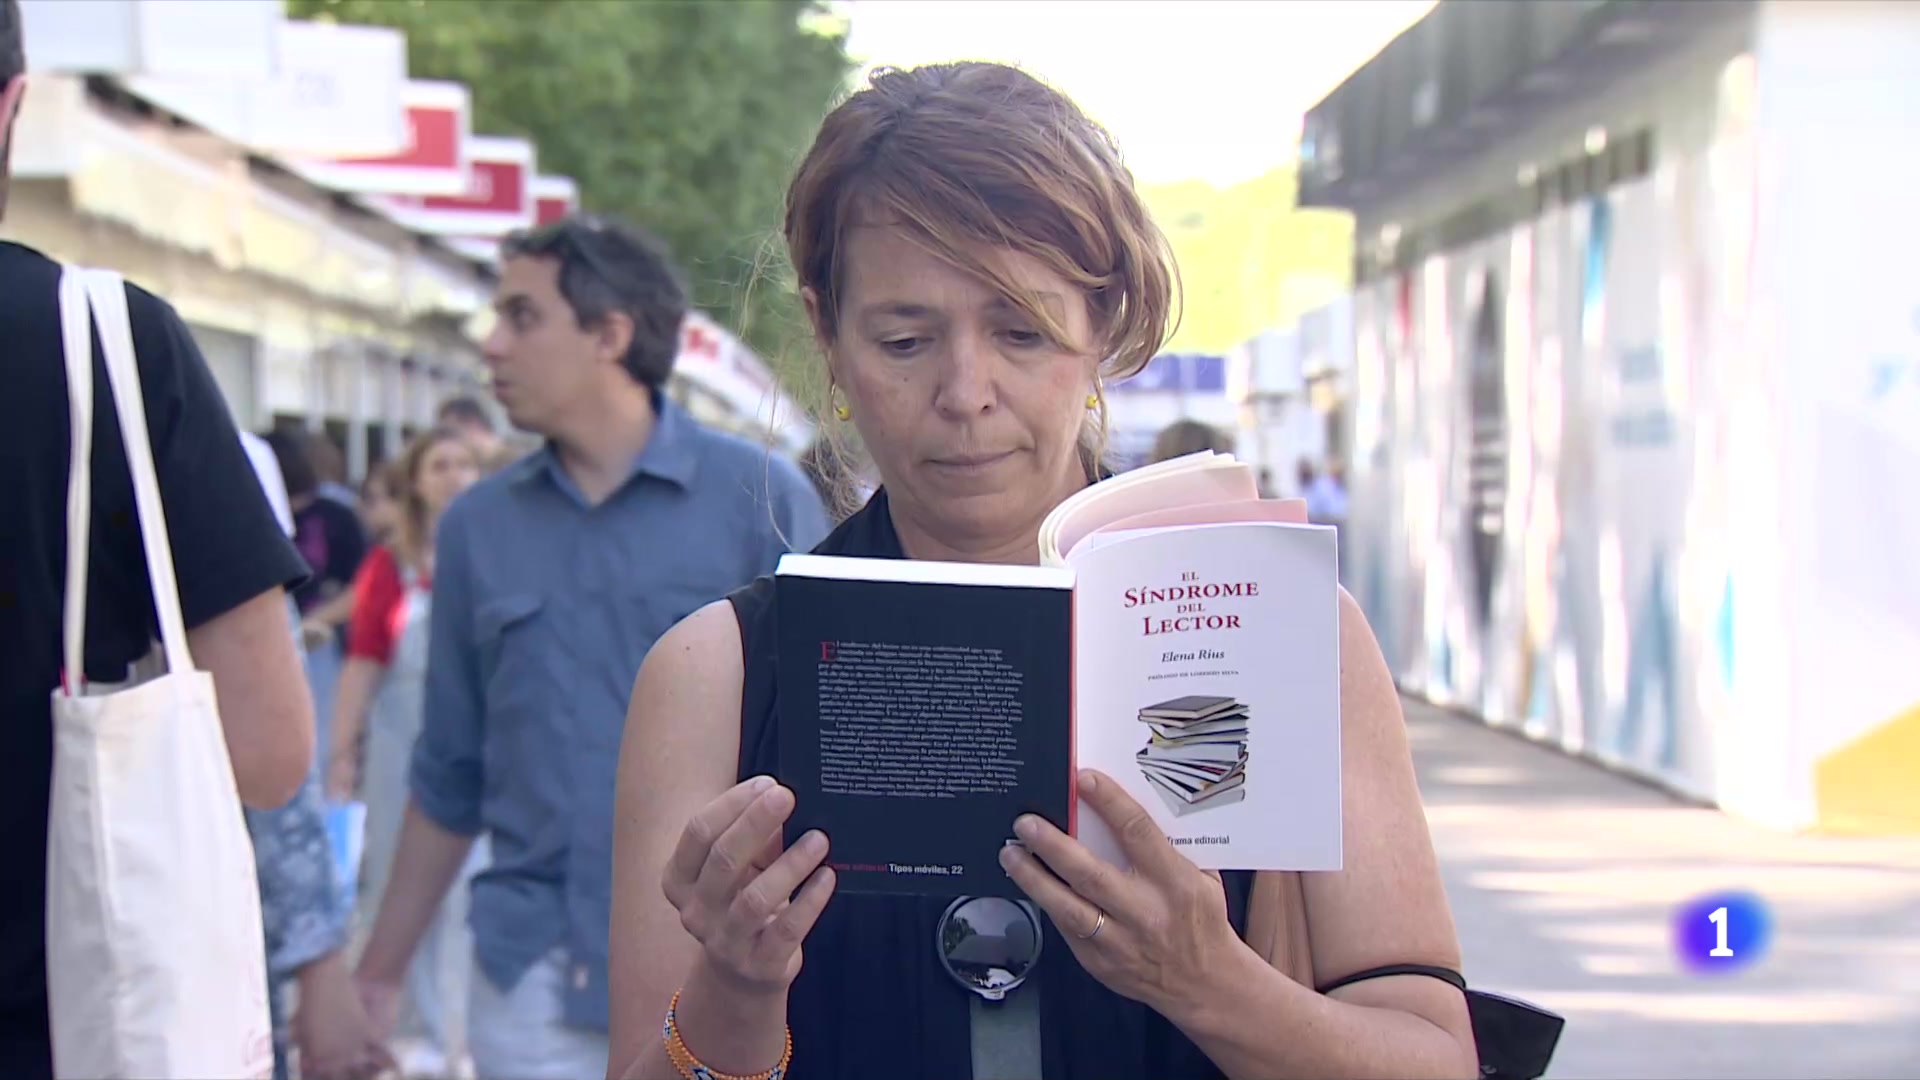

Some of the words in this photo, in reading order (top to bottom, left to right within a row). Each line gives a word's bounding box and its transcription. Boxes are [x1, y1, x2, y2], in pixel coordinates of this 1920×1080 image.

[1181, 571, 1199, 581] EL
[1123, 581, 1259, 608] SÍNDROME
[1177, 602, 1206, 614] DEL
[1142, 614, 1241, 636] LECTOR
[1161, 651, 1195, 663] Elena
[1198, 648, 1225, 660] Rius
[1194, 834, 1230, 845] editorial
[889, 863, 913, 874] Tipos
[951, 865, 964, 875] 22
